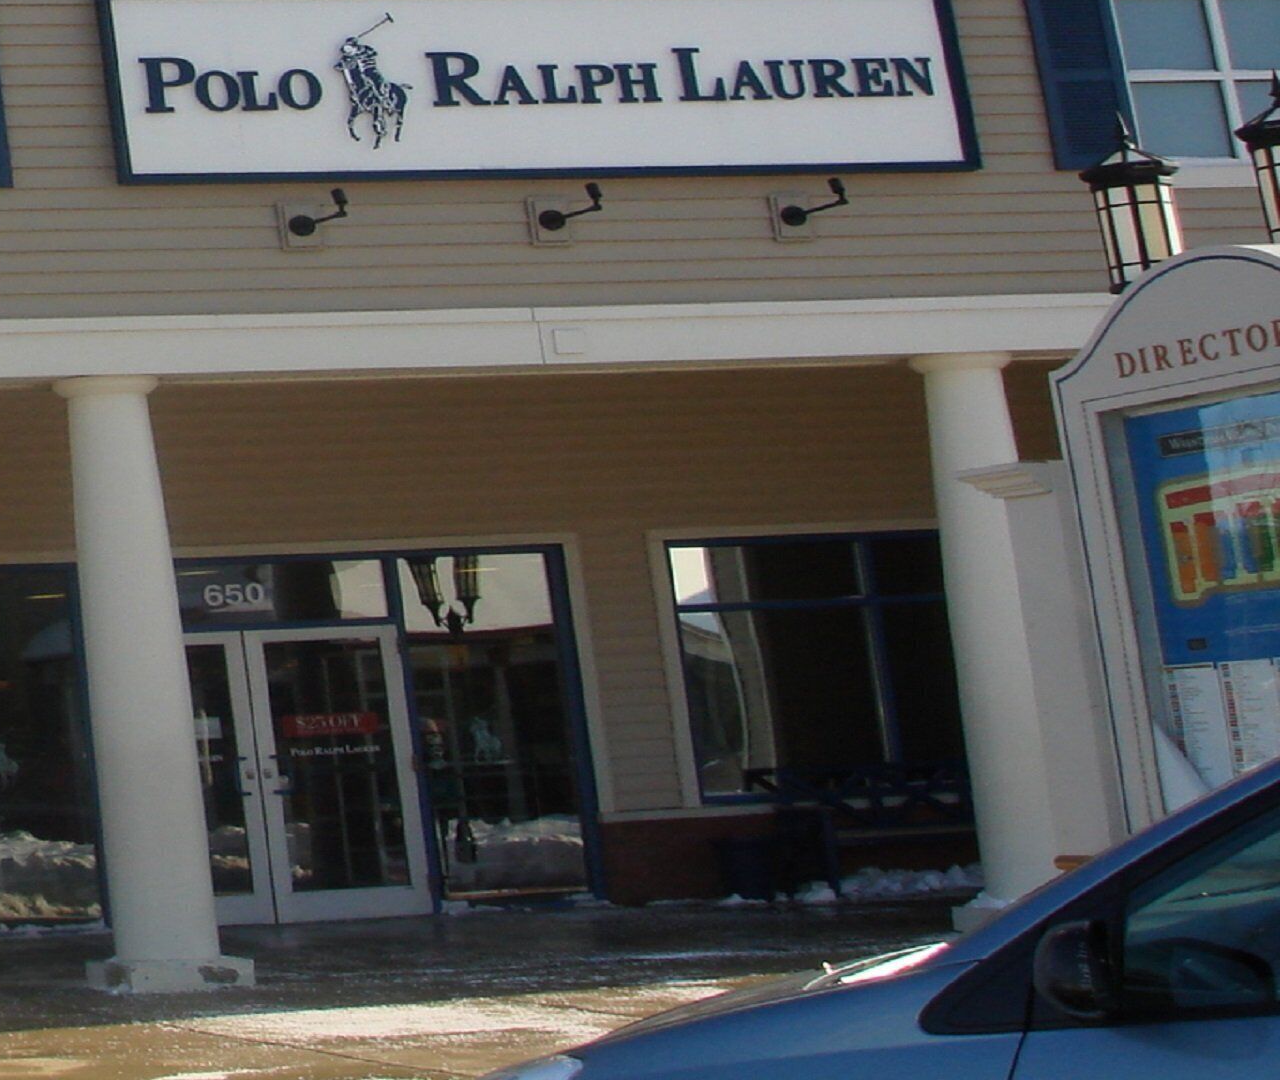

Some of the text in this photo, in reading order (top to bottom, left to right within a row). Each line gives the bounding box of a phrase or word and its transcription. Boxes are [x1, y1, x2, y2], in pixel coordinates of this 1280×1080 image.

[138, 47, 934, 113] POLO RALPH LAUREN
[203, 583, 264, 607] 650
